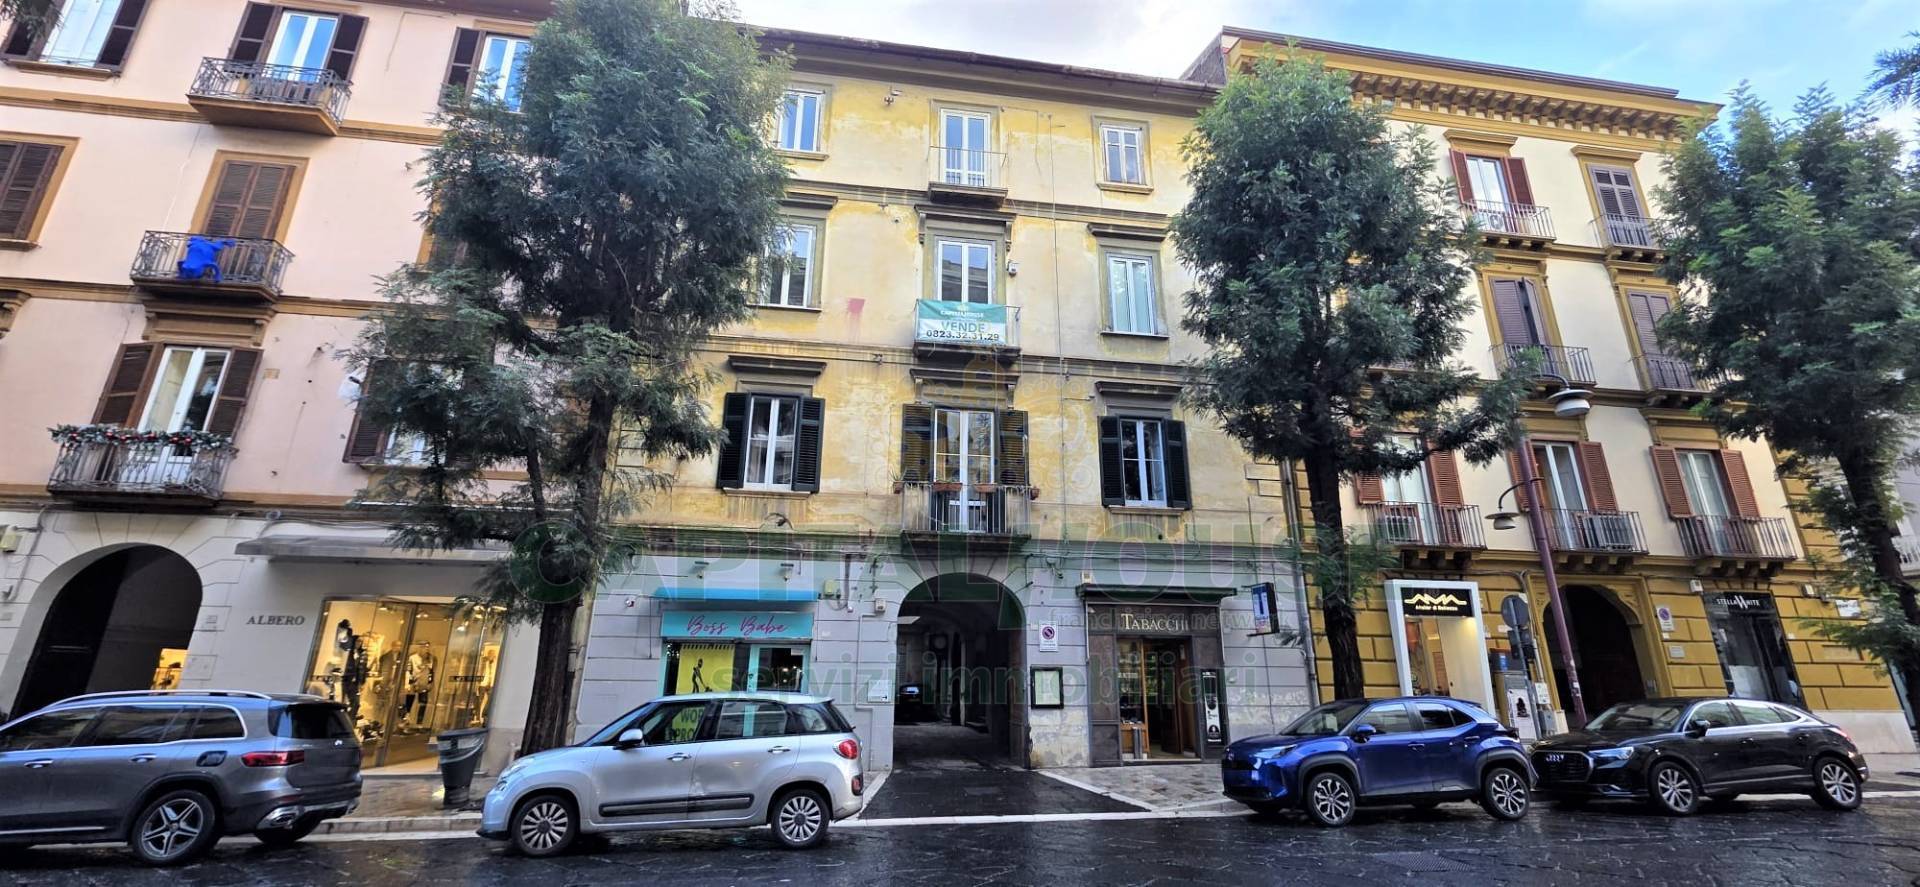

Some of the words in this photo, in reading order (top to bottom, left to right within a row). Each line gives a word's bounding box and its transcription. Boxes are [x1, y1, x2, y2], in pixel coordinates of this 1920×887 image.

[941, 320, 985, 333] VENDE
[926, 329, 1000, 341] 0823.32.31.29
[246, 615, 306, 625] ALBERO
[686, 615, 728, 635] Boss
[740, 615, 788, 636] Babe
[1121, 613, 1189, 632] TABACCHI
